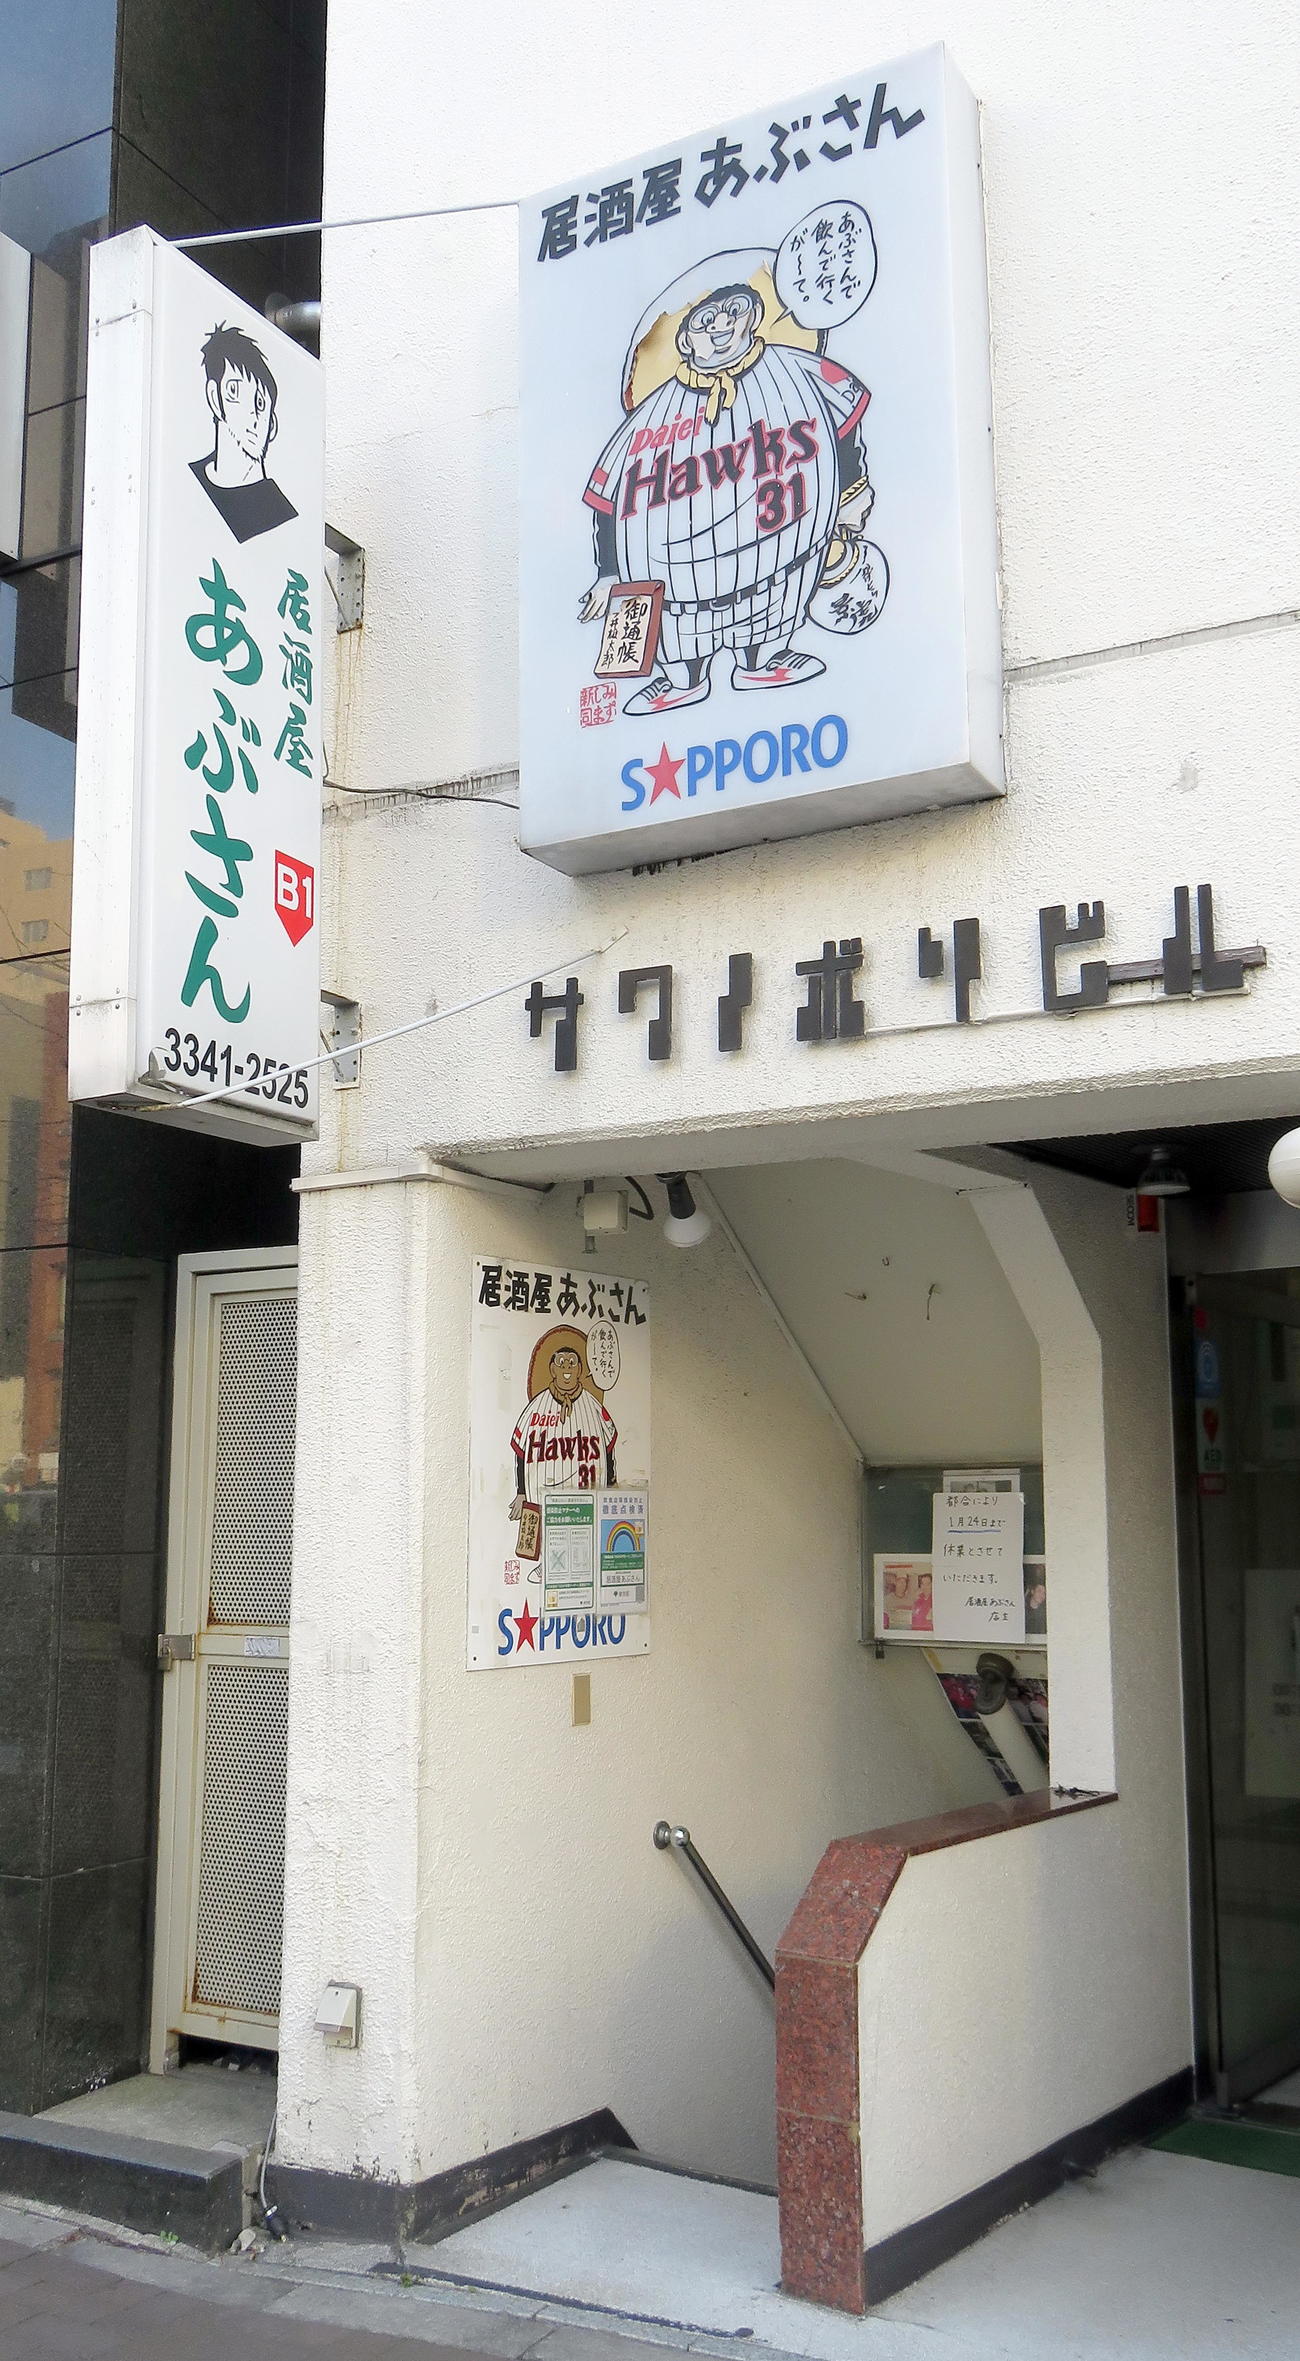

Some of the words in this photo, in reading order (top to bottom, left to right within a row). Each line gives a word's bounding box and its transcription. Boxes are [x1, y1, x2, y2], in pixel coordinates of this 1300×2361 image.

[537, 158, 682, 263] 居酒屋
[694, 82, 926, 208] あぶさん
[810, 218, 837, 305] 飲んで行く
[838, 210, 863, 299] あぶさんで
[629, 405, 706, 456] Daiei
[619, 415, 821, 522] Hawks
[755, 471, 808, 533] 31
[273, 567, 314, 780] 居酒屋
[180, 556, 264, 1024] あぶさん
[276, 861, 313, 921] B1
[163, 1027, 310, 1110] 3341-2525
[478, 1264, 553, 1314] 居酒屋
[556, 1272, 647, 1326] あぶさん
[526, 1429, 601, 1465] Hawks
[530, 1411, 560, 1428] Daiei
[578, 1463, 597, 1488] 31
[946, 1496, 999, 1507] 都合により
[943, 1543, 1004, 1558] 休業とさせて
[948, 1515, 1007, 1528] 1月24日まで
